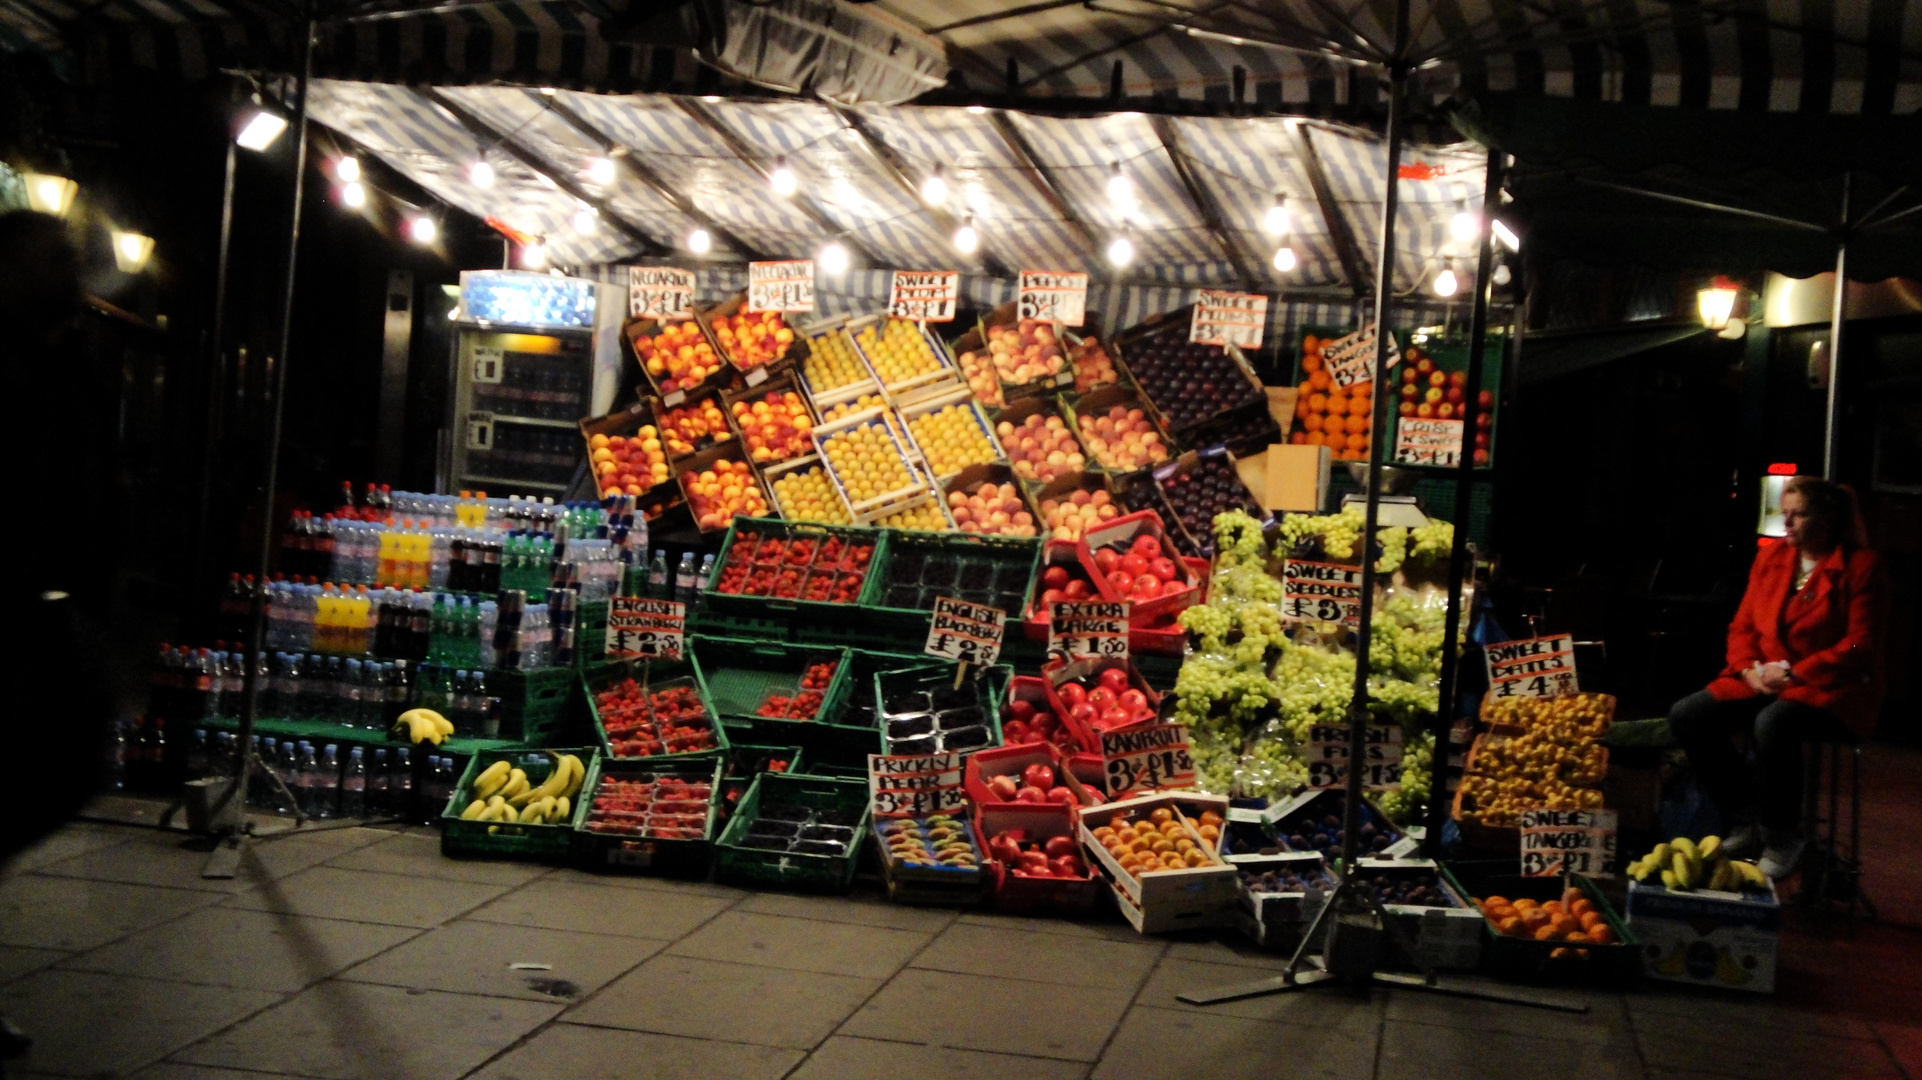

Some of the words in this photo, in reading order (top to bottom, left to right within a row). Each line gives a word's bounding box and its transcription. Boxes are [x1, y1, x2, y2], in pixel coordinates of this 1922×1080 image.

[632, 289, 650, 314] 3
[753, 284, 770, 308] 3
[1021, 292, 1040, 318] 3
[892, 301, 910, 317] 3
[1335, 369, 1355, 387] 3
[1398, 447, 1420, 464] 3
[1285, 562, 1356, 583] SWEET
[612, 600, 677, 615] ENGLISH
[937, 599, 998, 625] ENGLISH
[1054, 602, 1123, 618] EXTRA
[1052, 619, 1121, 635] LARGE
[1489, 640, 1566, 663] SWEET
[1491, 655, 1564, 679] DATES
[1322, 744, 1384, 760] FIS
[873, 754, 951, 773] PRICKLY
[1309, 760, 1339, 788] 3
[878, 775, 942, 790] PEAR
[1107, 757, 1136, 793] 3
[875, 791, 898, 813] 3
[1524, 852, 1547, 876] 3
